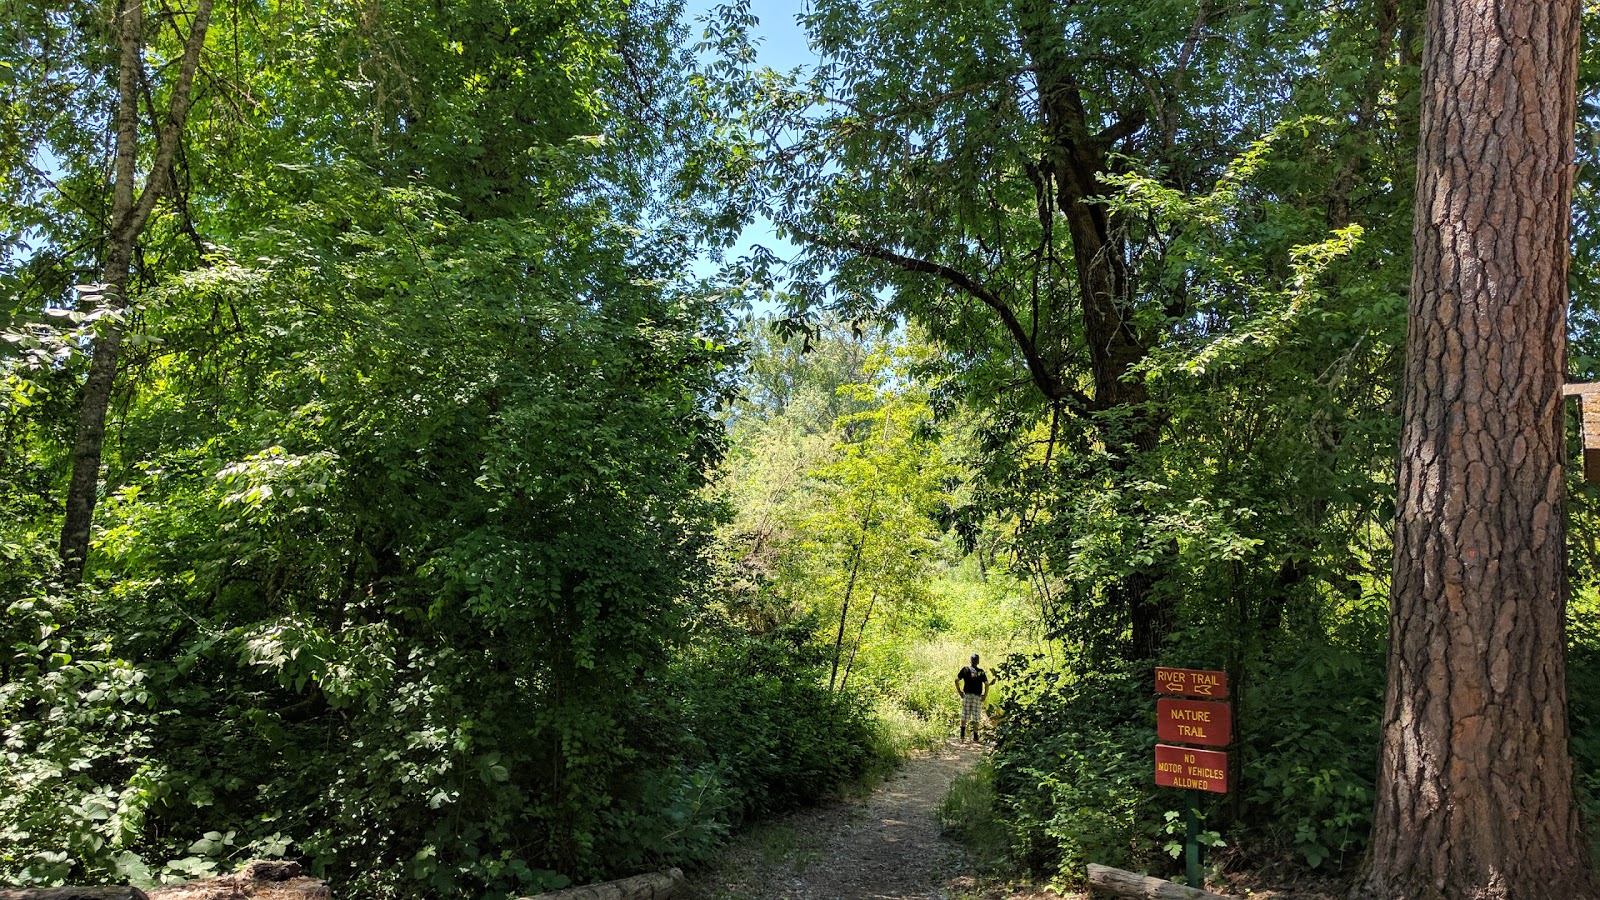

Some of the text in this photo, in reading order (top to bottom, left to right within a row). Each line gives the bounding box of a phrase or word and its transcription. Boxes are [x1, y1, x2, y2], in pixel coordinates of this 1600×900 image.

[1158, 671, 1220, 686] RIVER TRAIL
[1171, 710, 1210, 722] NATURE
[1178, 725, 1206, 738] TRAIL
[1184, 754, 1195, 764] NO
[1158, 763, 1224, 780] MOTOR VEHICLES
[1173, 777, 1208, 790] ALLOWED
